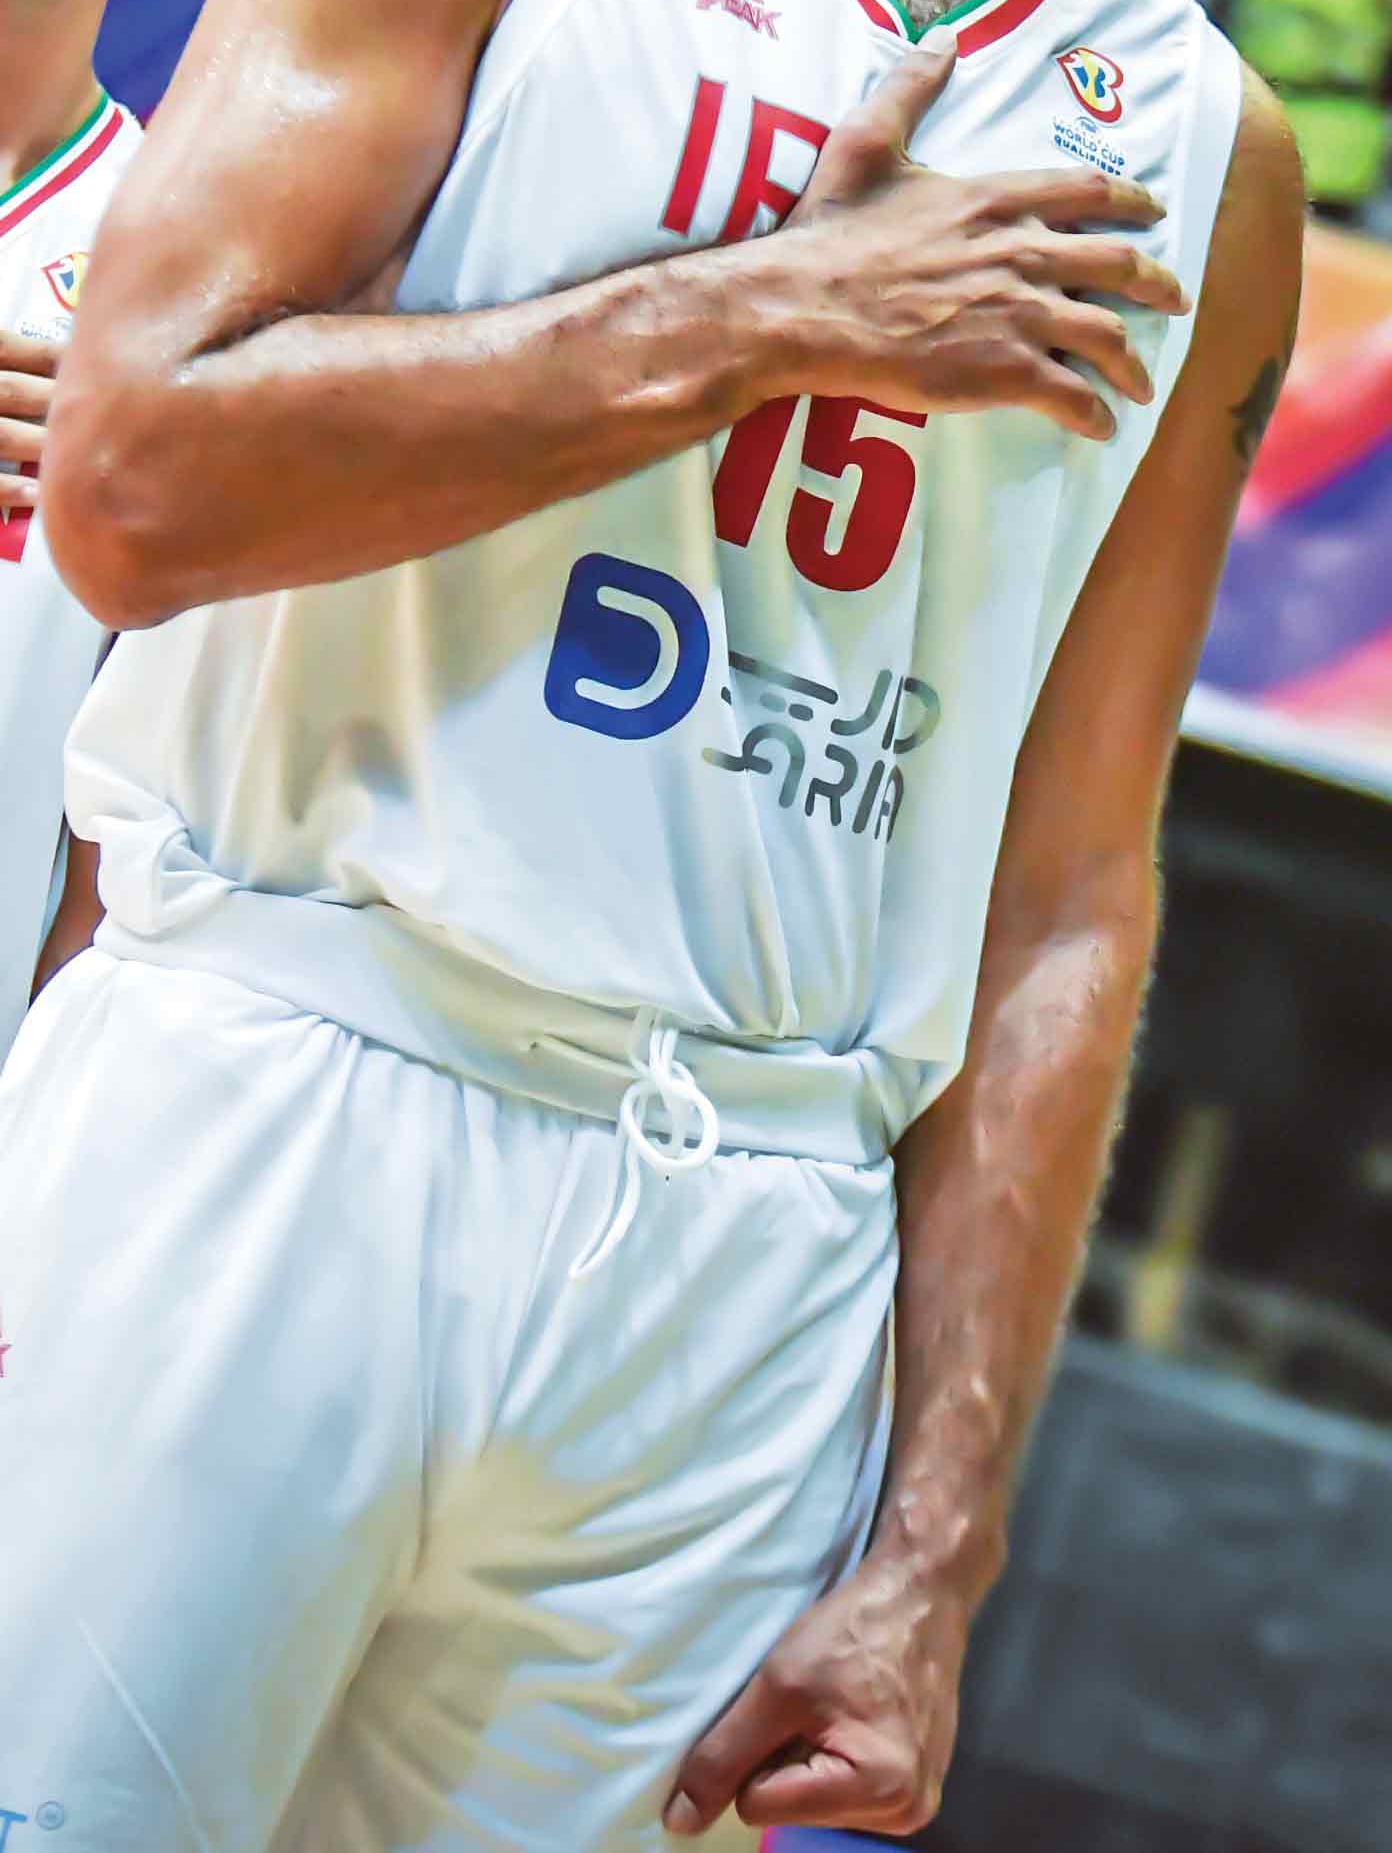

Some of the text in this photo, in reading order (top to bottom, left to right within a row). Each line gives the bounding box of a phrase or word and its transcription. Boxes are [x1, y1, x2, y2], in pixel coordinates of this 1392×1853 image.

[659, 75, 831, 243] IR
[1101, 147, 1126, 166] CUP
[712, 393, 929, 592] 15
